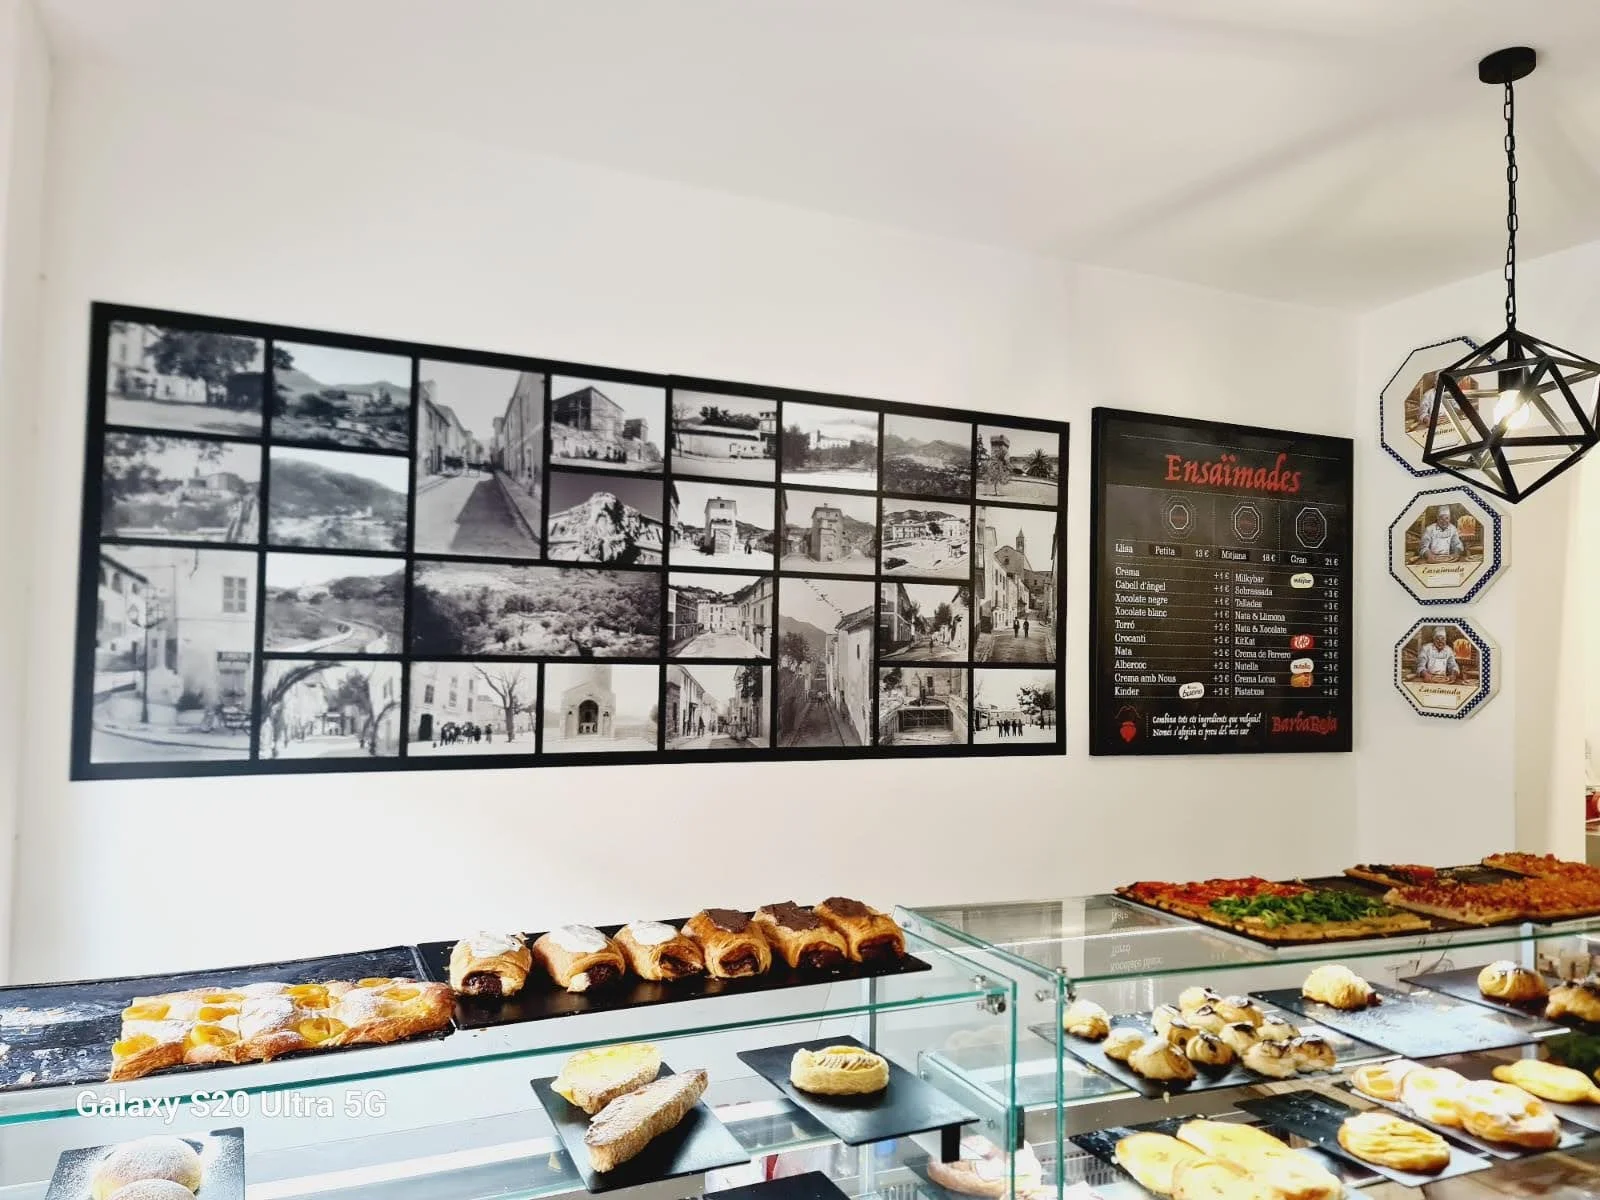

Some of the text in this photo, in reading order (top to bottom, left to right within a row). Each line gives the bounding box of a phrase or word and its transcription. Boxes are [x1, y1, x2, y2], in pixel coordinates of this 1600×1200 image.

[1165, 452, 1302, 493] Ensaïmades
[1115, 544, 1134, 554] Llisa
[1155, 546, 1176, 556] Petita
[1194, 549, 1203, 558] 13
[1221, 550, 1247, 560] Mitjana
[1262, 554, 1270, 562] 18
[1290, 554, 1307, 564] Gran
[1324, 558, 1333, 566] 21
[1115, 566, 1140, 576] Crema
[1235, 573, 1265, 584] Milkybar
[1115, 580, 1138, 589] Cabell
[1235, 586, 1273, 596] Sobrassada
[1115, 593, 1147, 603] Xocolate
[1148, 596, 1169, 606] negre
[1235, 599, 1263, 608] Tallades
[1115, 606, 1147, 616] Xocolate
[1147, 608, 1168, 617] blanc
[1235, 611, 1251, 620] Nata
[1260, 612, 1286, 622] Llimona
[1115, 620, 1135, 629] Torró
[1235, 624, 1251, 633] Nata
[1252, 625, 1258, 633] &
[1260, 625, 1288, 634] Xocolate
[1114, 633, 1146, 643] Crocanti
[1234, 636, 1256, 646] KitKat
[1114, 646, 1132, 656] Nata
[1234, 649, 1257, 658] Crema
[1258, 649, 1266, 658] de
[1267, 650, 1291, 659] Ferrero
[1114, 659, 1147, 669] Albercoc
[1234, 662, 1259, 671] Nutella
[1114, 673, 1139, 683] Crema
[1140, 674, 1157, 683] amb
[1158, 674, 1177, 683] Nous
[1234, 674, 1257, 684] Crema
[1258, 674, 1276, 684] Lotus
[1114, 686, 1140, 696] Kinder
[1198, 712, 1227, 728] ingredients
[1228, 716, 1238, 728] que
[1272, 710, 1337, 735] BarbaRoja
[1152, 724, 1172, 737] Només
[1218, 725, 1228, 736] del
[1239, 728, 1249, 736] car
